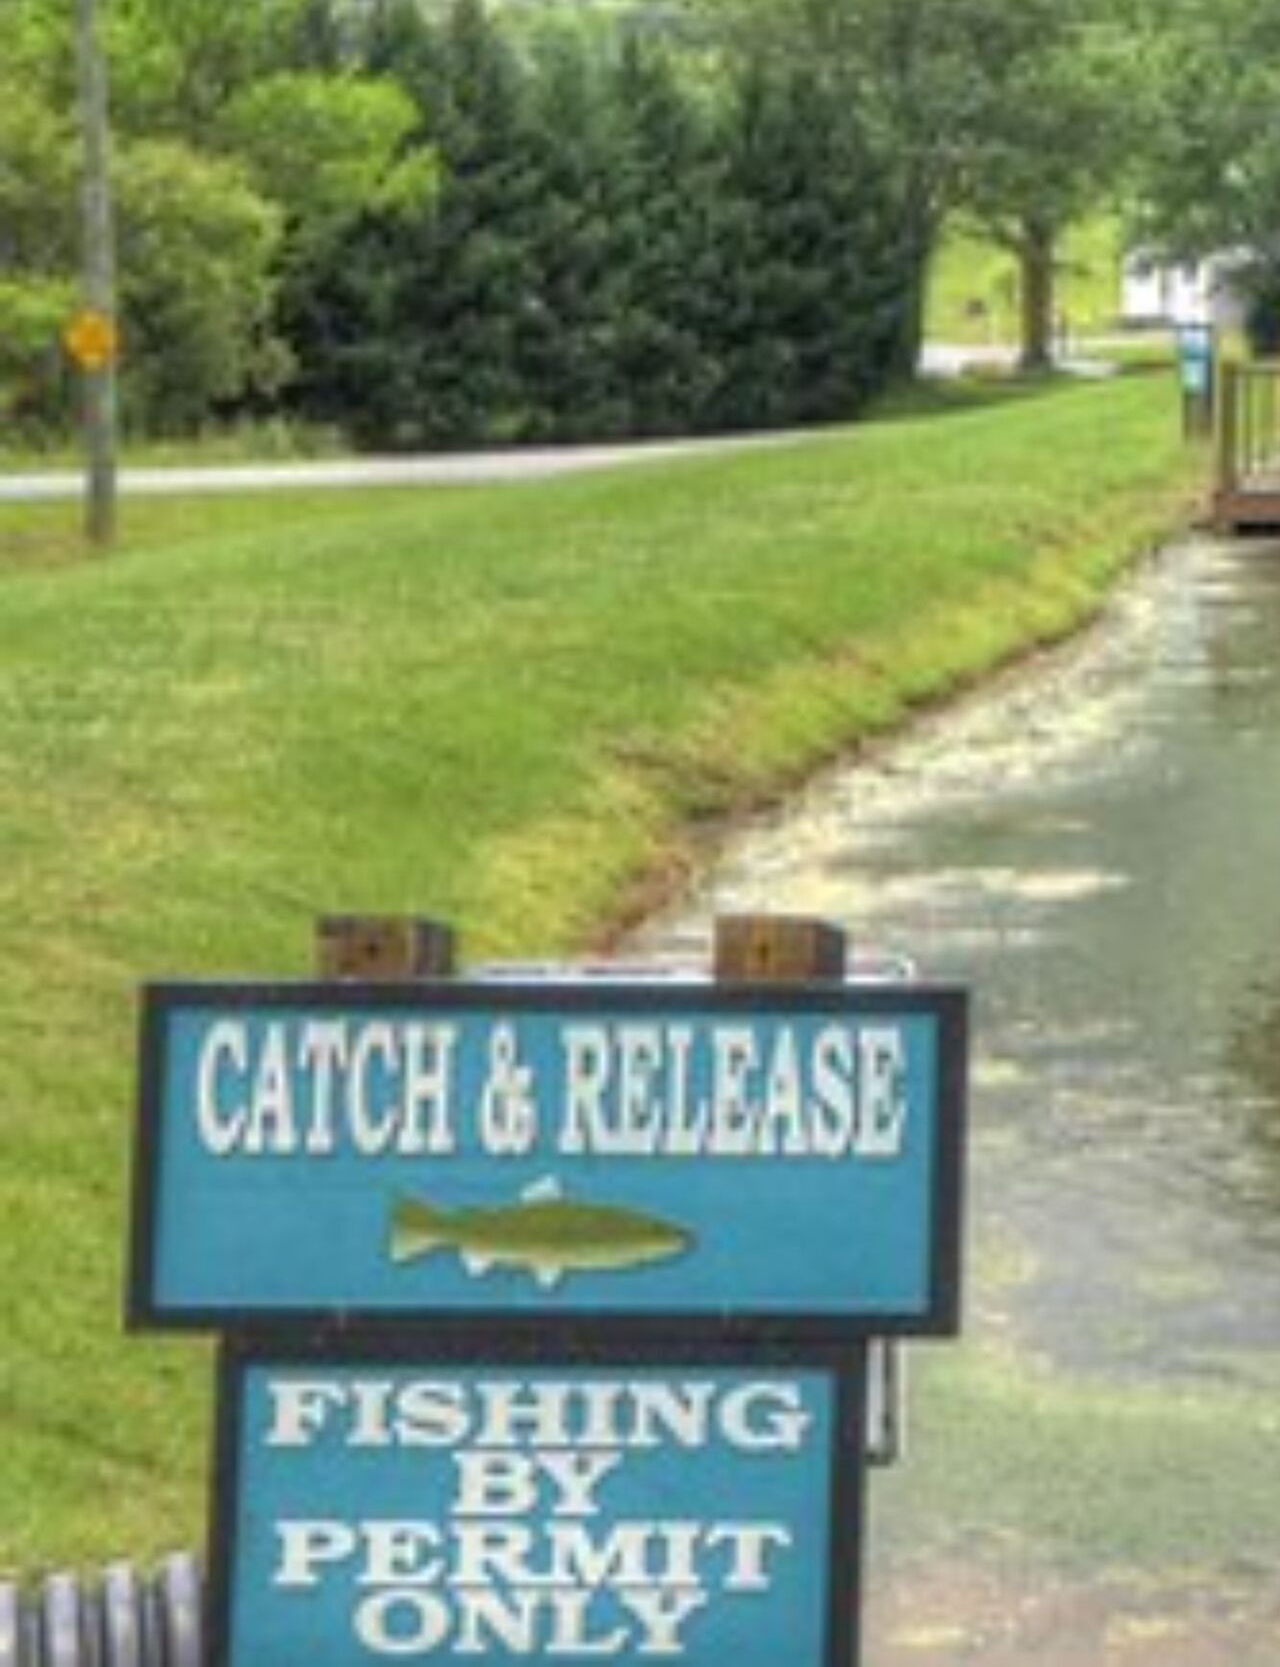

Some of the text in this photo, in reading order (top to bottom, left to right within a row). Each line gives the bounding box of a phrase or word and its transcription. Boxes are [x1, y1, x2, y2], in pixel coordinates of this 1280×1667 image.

[198, 1020, 908, 1158] CATCH & RELEASE
[265, 1380, 812, 1448] FISHING
[450, 1451, 621, 1516] BY
[273, 1521, 792, 1589] PERMIT
[352, 1590, 710, 1655] ONLY
